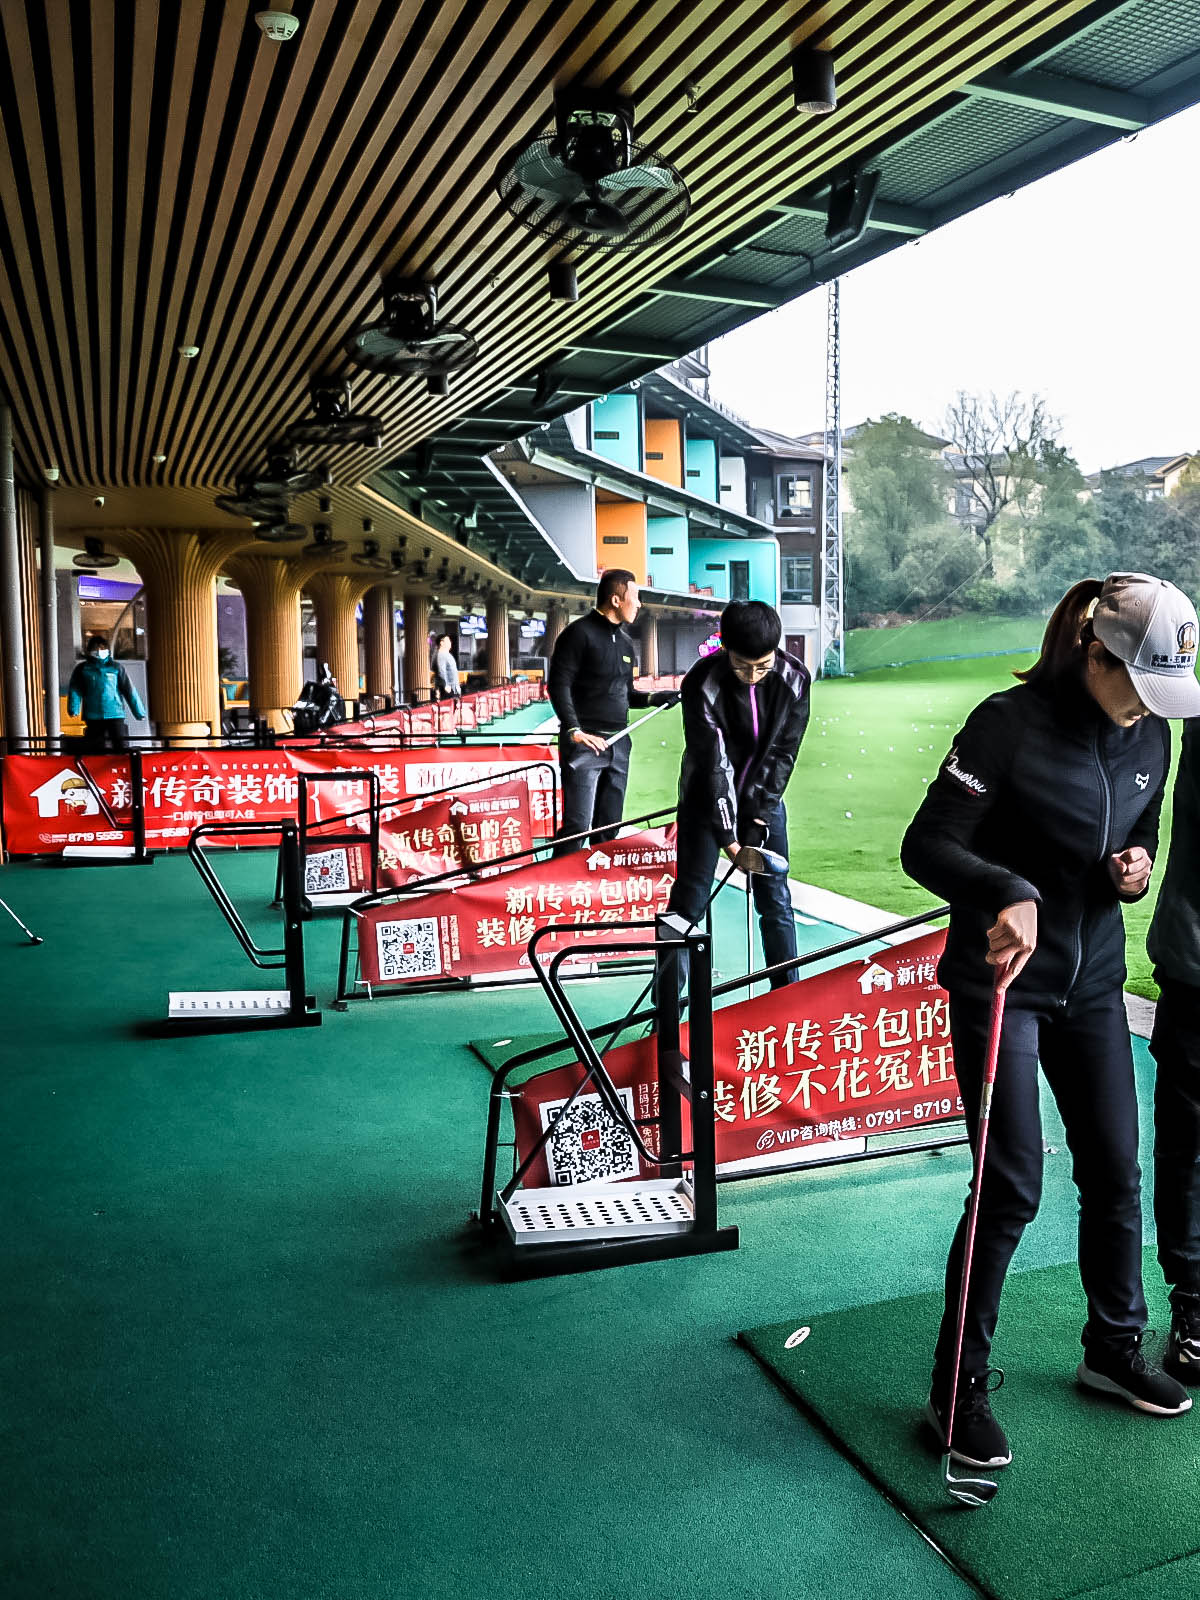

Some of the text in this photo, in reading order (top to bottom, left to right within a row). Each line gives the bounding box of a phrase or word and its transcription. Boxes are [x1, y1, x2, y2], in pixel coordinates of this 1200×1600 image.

[110, 773, 299, 809] 新传奇装饰
[504, 873, 676, 915] 新传奇包的全
[735, 998, 951, 1073] 新传奇包的
